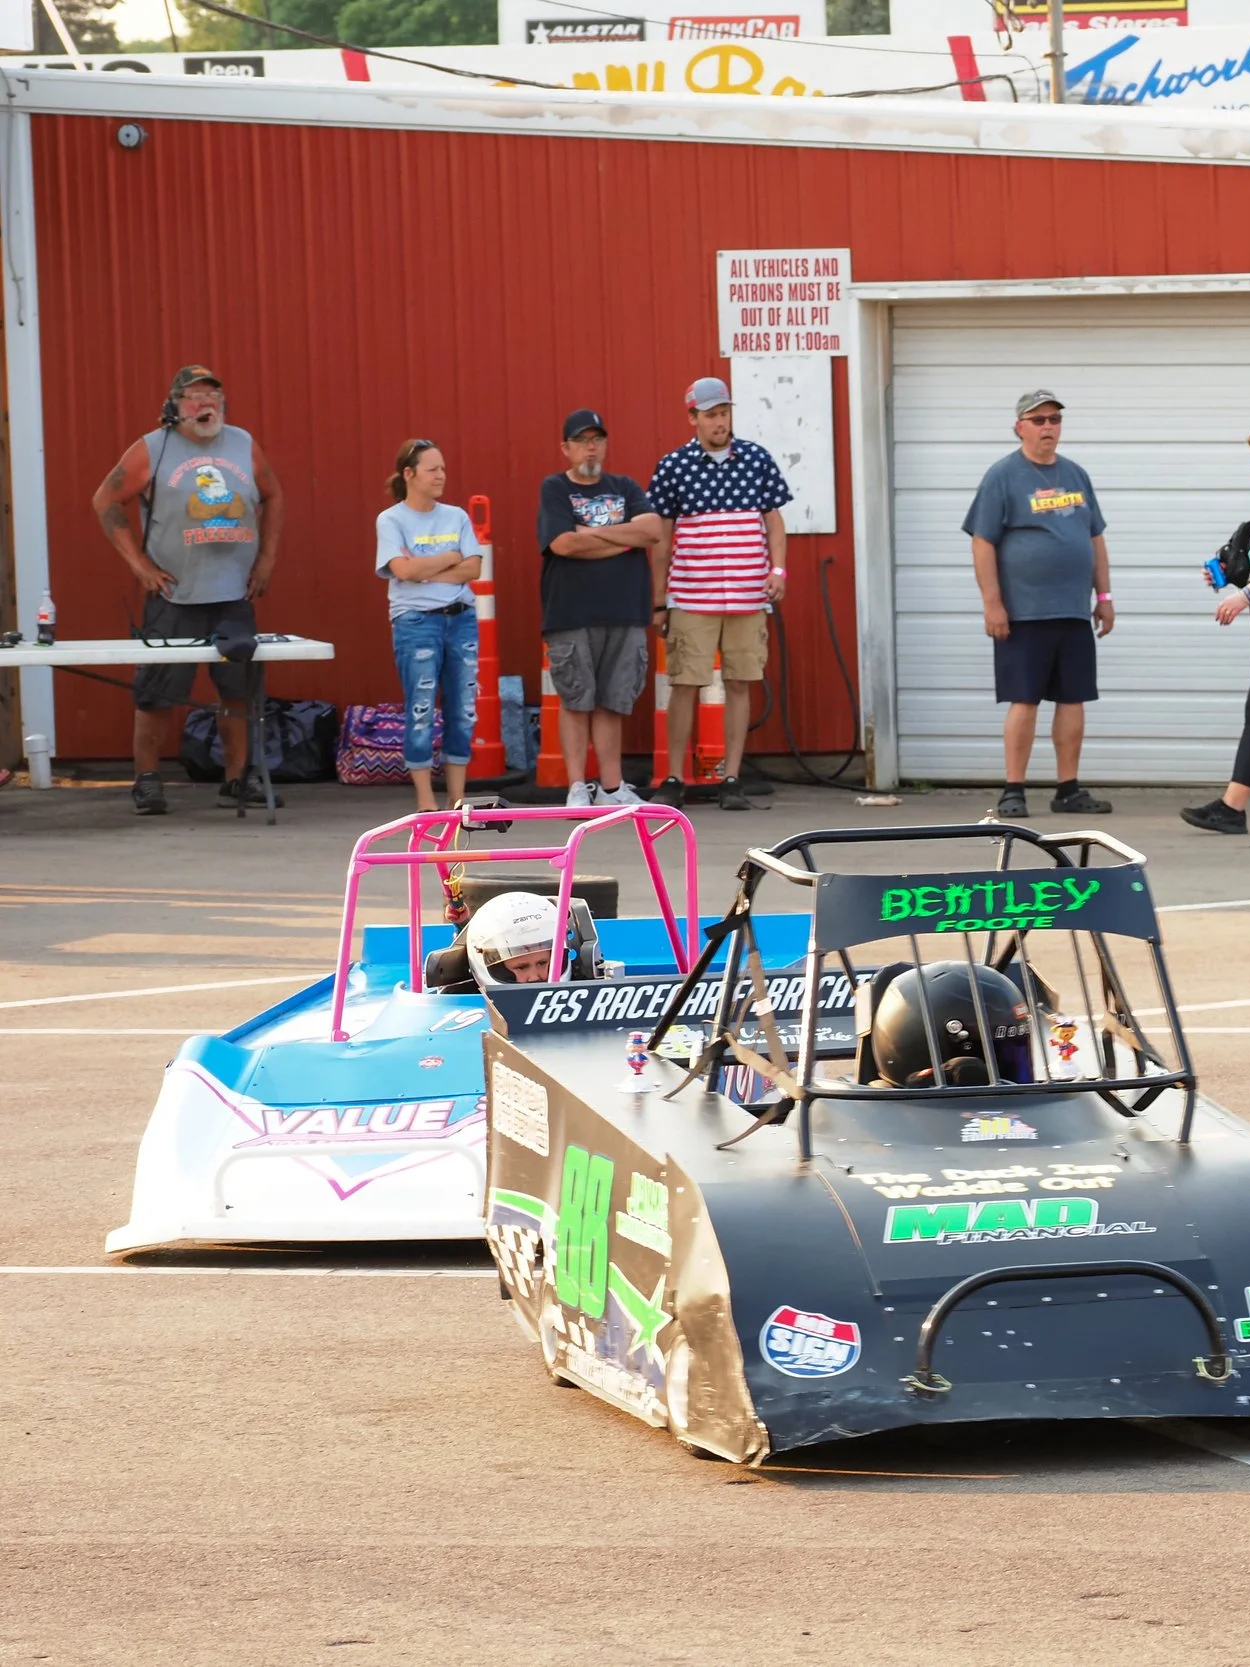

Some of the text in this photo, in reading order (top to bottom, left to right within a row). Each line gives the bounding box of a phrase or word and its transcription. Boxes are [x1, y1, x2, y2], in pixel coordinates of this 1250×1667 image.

[549, 23, 641, 37] ALLSTAR
[754, 257, 809, 279] VEHICLES
[814, 257, 839, 277] AND
[729, 281, 841, 303] PATRONS MUST BE
[741, 306, 830, 327] OUT OF ALL PIT
[733, 331, 841, 352] AREAS BY 1:00am
[879, 877, 1101, 922] BENTLEY
[935, 916, 1056, 933] FOOTE
[525, 988, 589, 1026] F&S
[261, 1100, 456, 1135] VALUE
[848, 1172, 932, 1185] The
[874, 1175, 1116, 1199] Waddle Out
[884, 1197, 1099, 1244] MAD
[936, 1222, 1158, 1246] FINANCIAL
